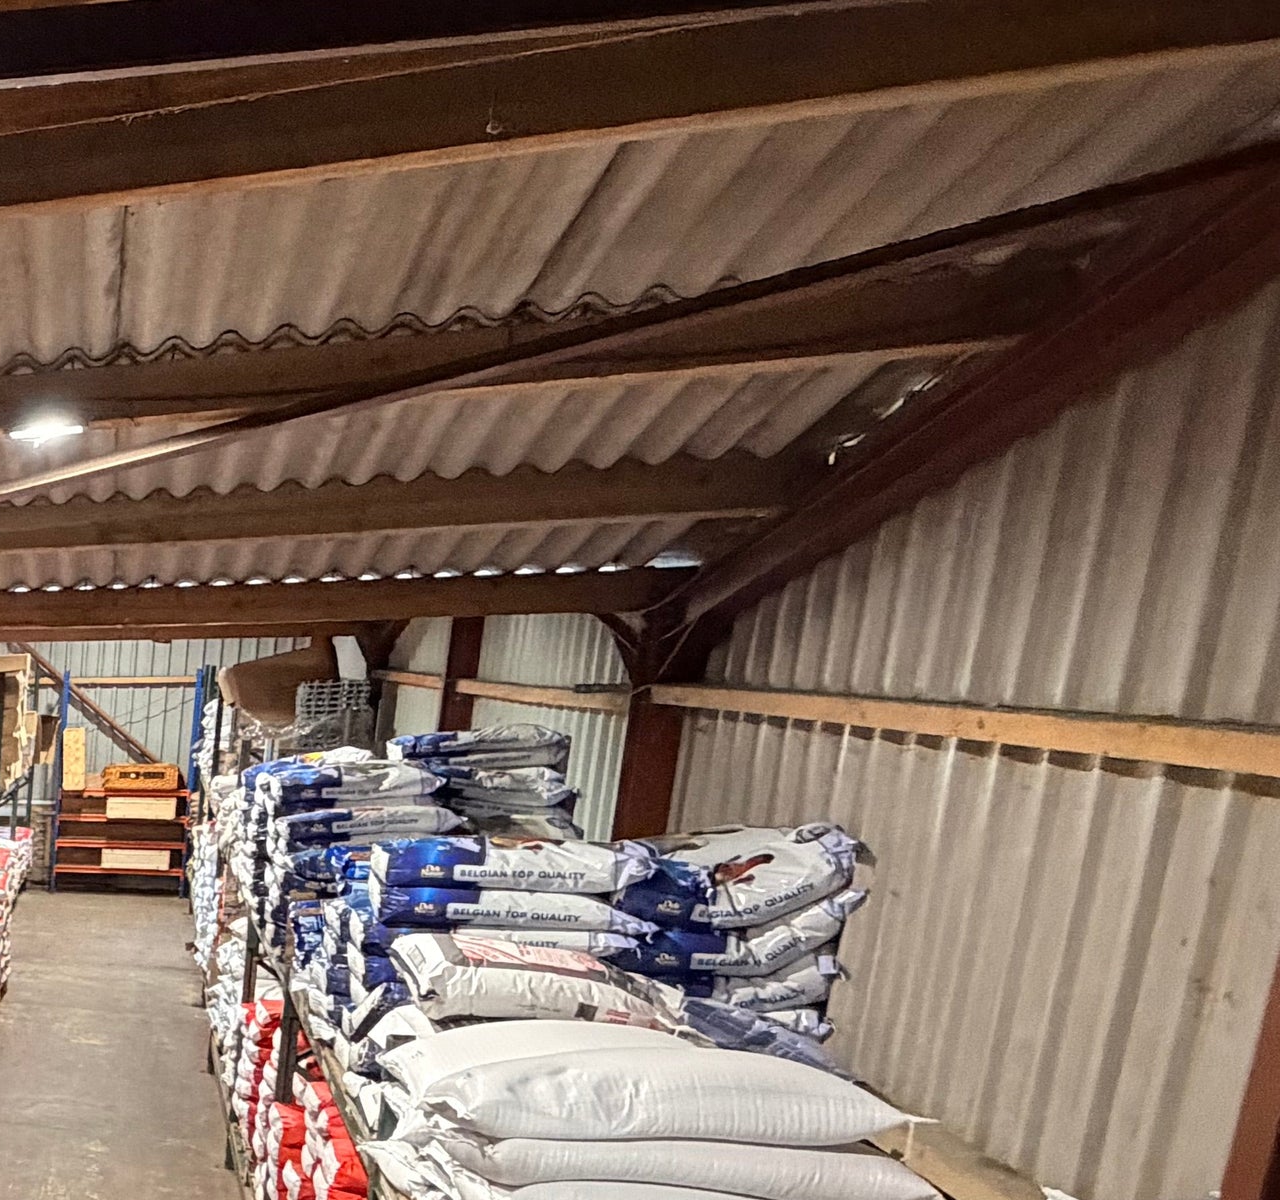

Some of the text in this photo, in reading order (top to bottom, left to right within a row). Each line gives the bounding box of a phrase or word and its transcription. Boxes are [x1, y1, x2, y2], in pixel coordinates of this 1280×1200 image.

[459, 868, 586, 881] BELGIAN TOP QUALITY
[453, 907, 582, 923] BELGIAN TOP QUALITY
